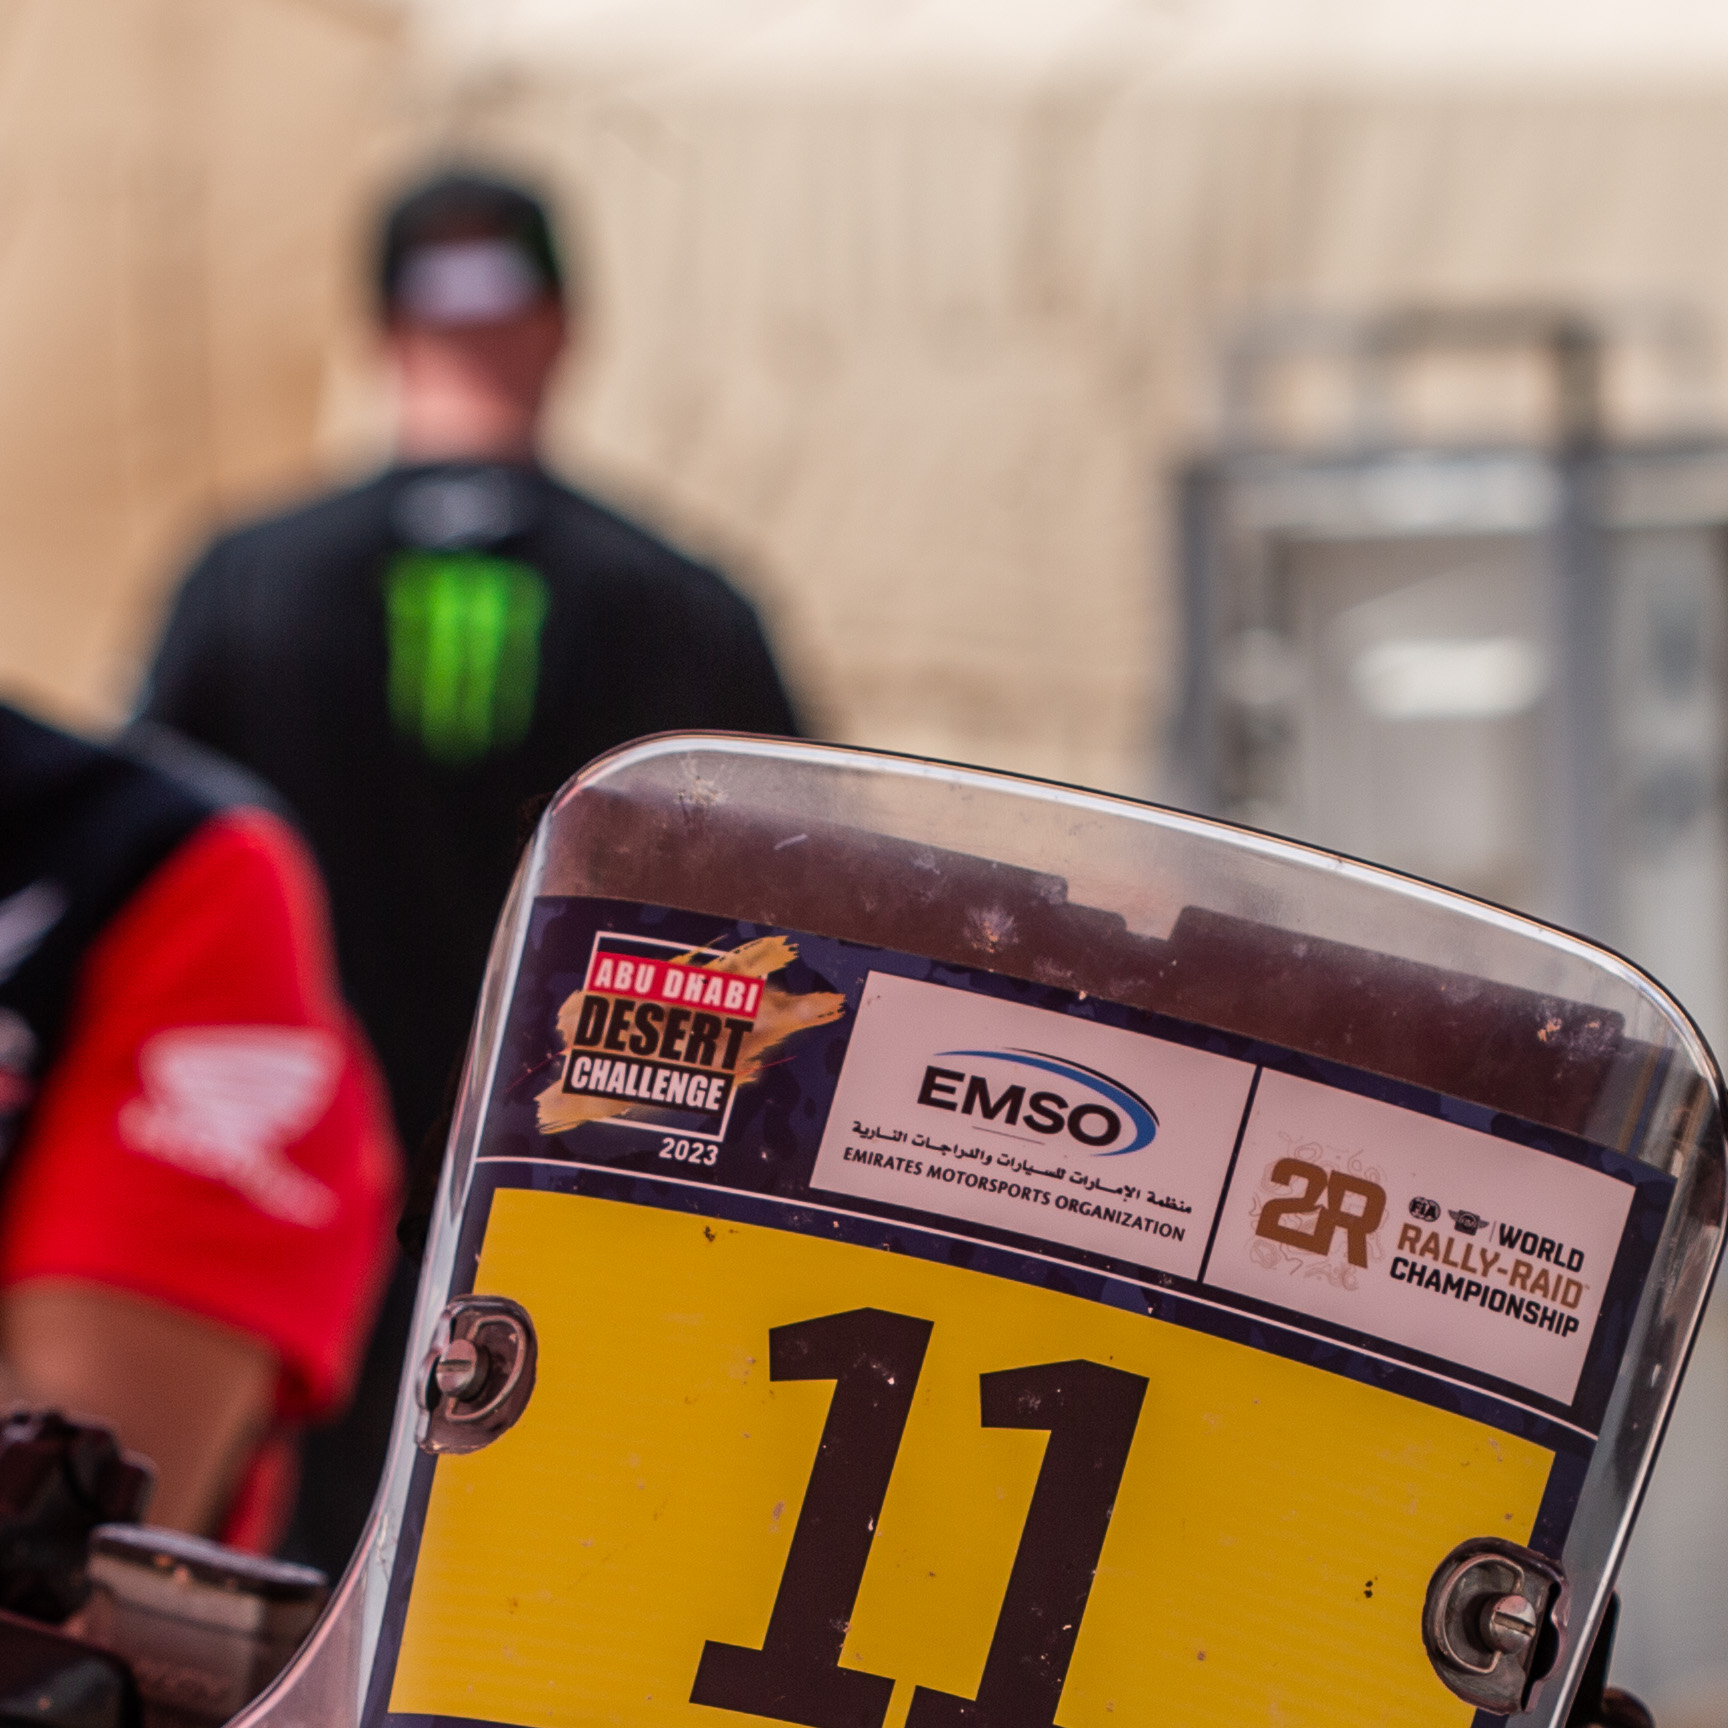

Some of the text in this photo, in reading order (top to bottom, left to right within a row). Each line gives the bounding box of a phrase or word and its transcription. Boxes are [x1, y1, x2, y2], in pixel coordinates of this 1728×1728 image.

[594, 958, 760, 1012] ABU DHABI
[574, 994, 755, 1070] DESERT
[571, 1056, 725, 1111] CHALLENGE
[917, 1065, 1121, 1146] EMSO
[659, 1137, 718, 1166] 2023
[843, 1147, 1186, 1242] EMIRATES MOTORSPORTS ORGANIZATION
[1410, 1198, 1439, 1221] FIA
[1397, 1222, 1583, 1310] RALLY-RAID
[1499, 1223, 1585, 1273] WORLD
[1390, 1256, 1580, 1338] CHAMPIONSHIP
